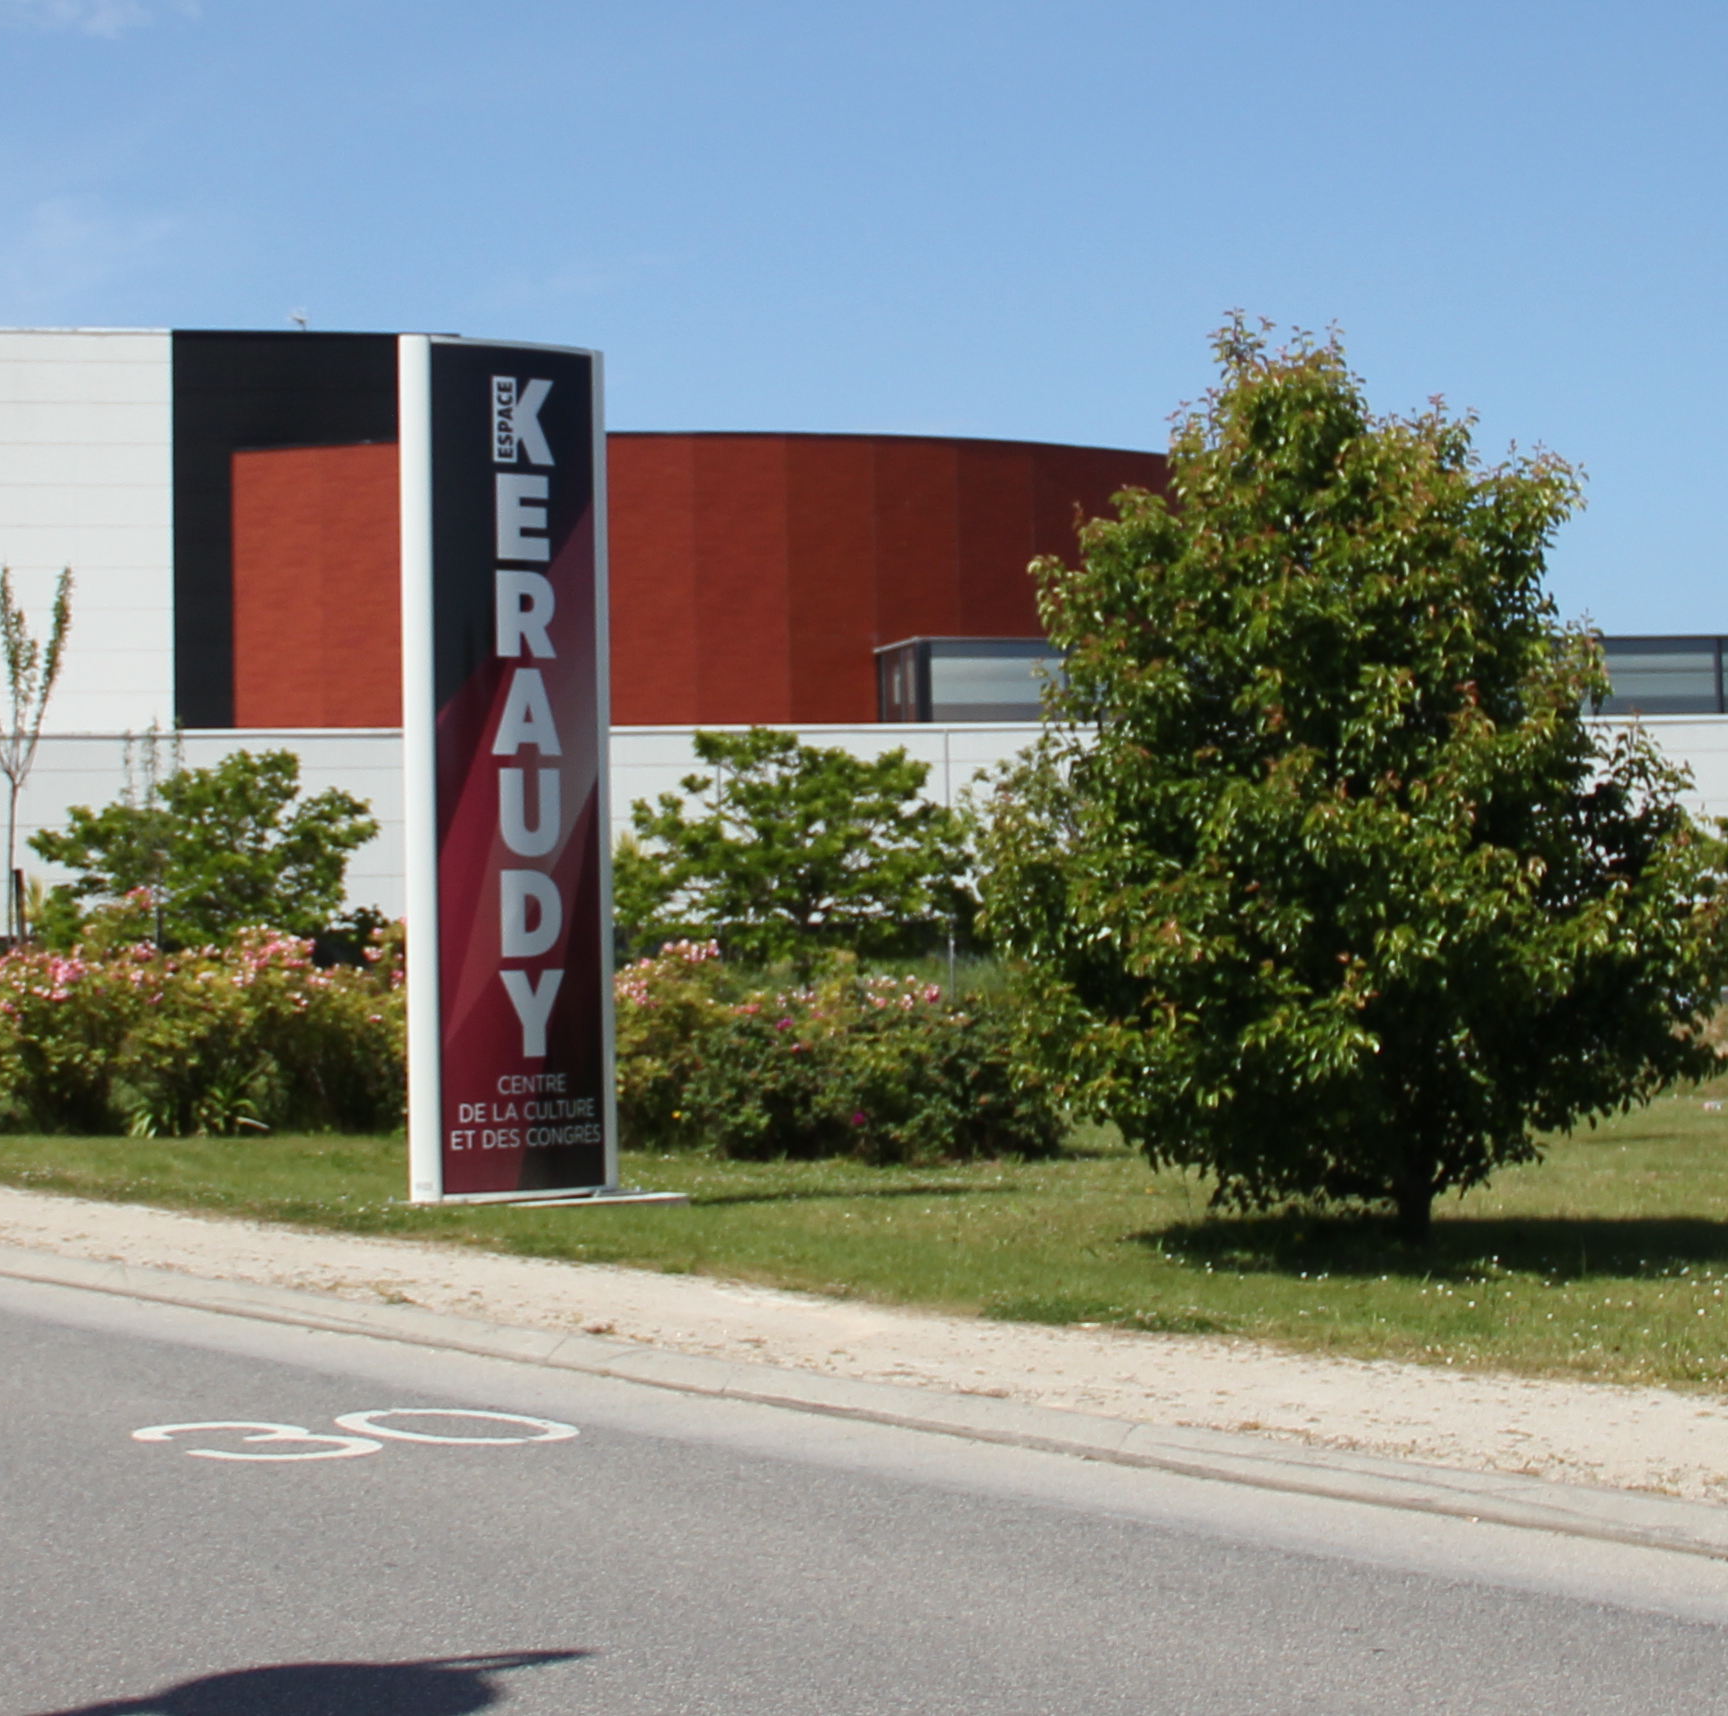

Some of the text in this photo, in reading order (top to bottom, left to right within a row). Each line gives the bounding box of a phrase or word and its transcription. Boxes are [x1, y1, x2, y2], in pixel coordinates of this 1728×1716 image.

[496, 381, 514, 459] ESPACE
[491, 375, 564, 1058] KERAUDY
[497, 1074, 566, 1094] CENTRE
[459, 1098, 595, 1123] DE LA CULTURE
[451, 1130, 476, 1150] ET
[482, 1129, 520, 1149] DES
[131, 1408, 579, 1460] 30
